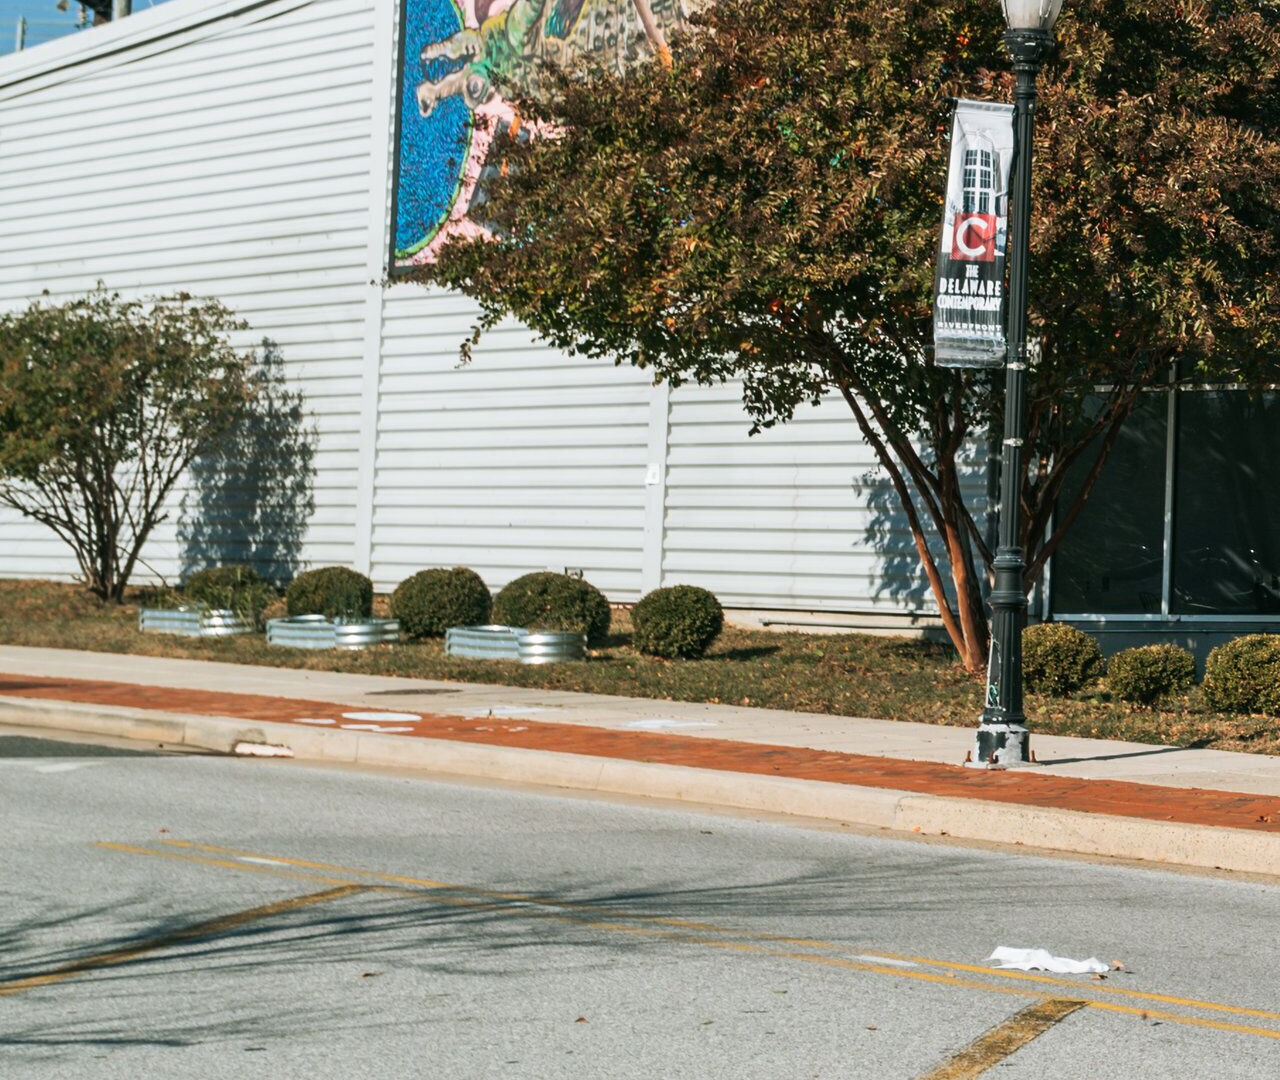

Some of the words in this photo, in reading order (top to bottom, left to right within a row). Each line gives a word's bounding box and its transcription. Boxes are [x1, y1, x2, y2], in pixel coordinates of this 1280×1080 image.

[956, 216, 988, 257] C
[965, 264, 979, 278] THE
[939, 277, 1002, 296] DELAWARE
[937, 294, 1002, 311] CONTEMPORARY
[937, 321, 1002, 331] RIVERFRONT
